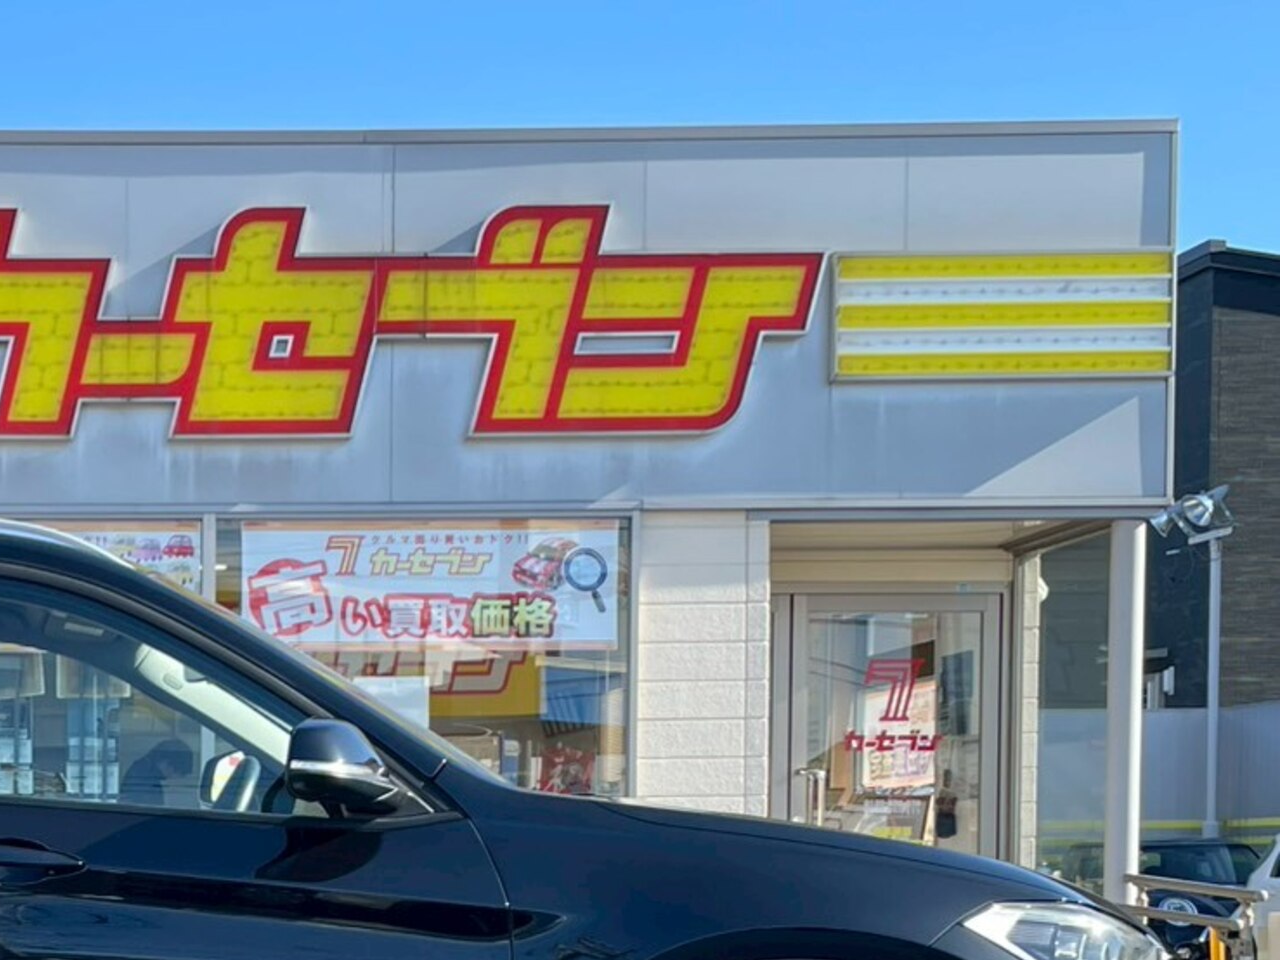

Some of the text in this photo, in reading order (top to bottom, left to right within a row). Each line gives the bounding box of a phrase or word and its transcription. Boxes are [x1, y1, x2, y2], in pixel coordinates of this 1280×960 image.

[369, 547, 493, 576] カーセブン
[844, 729, 943, 752] カーセブン
